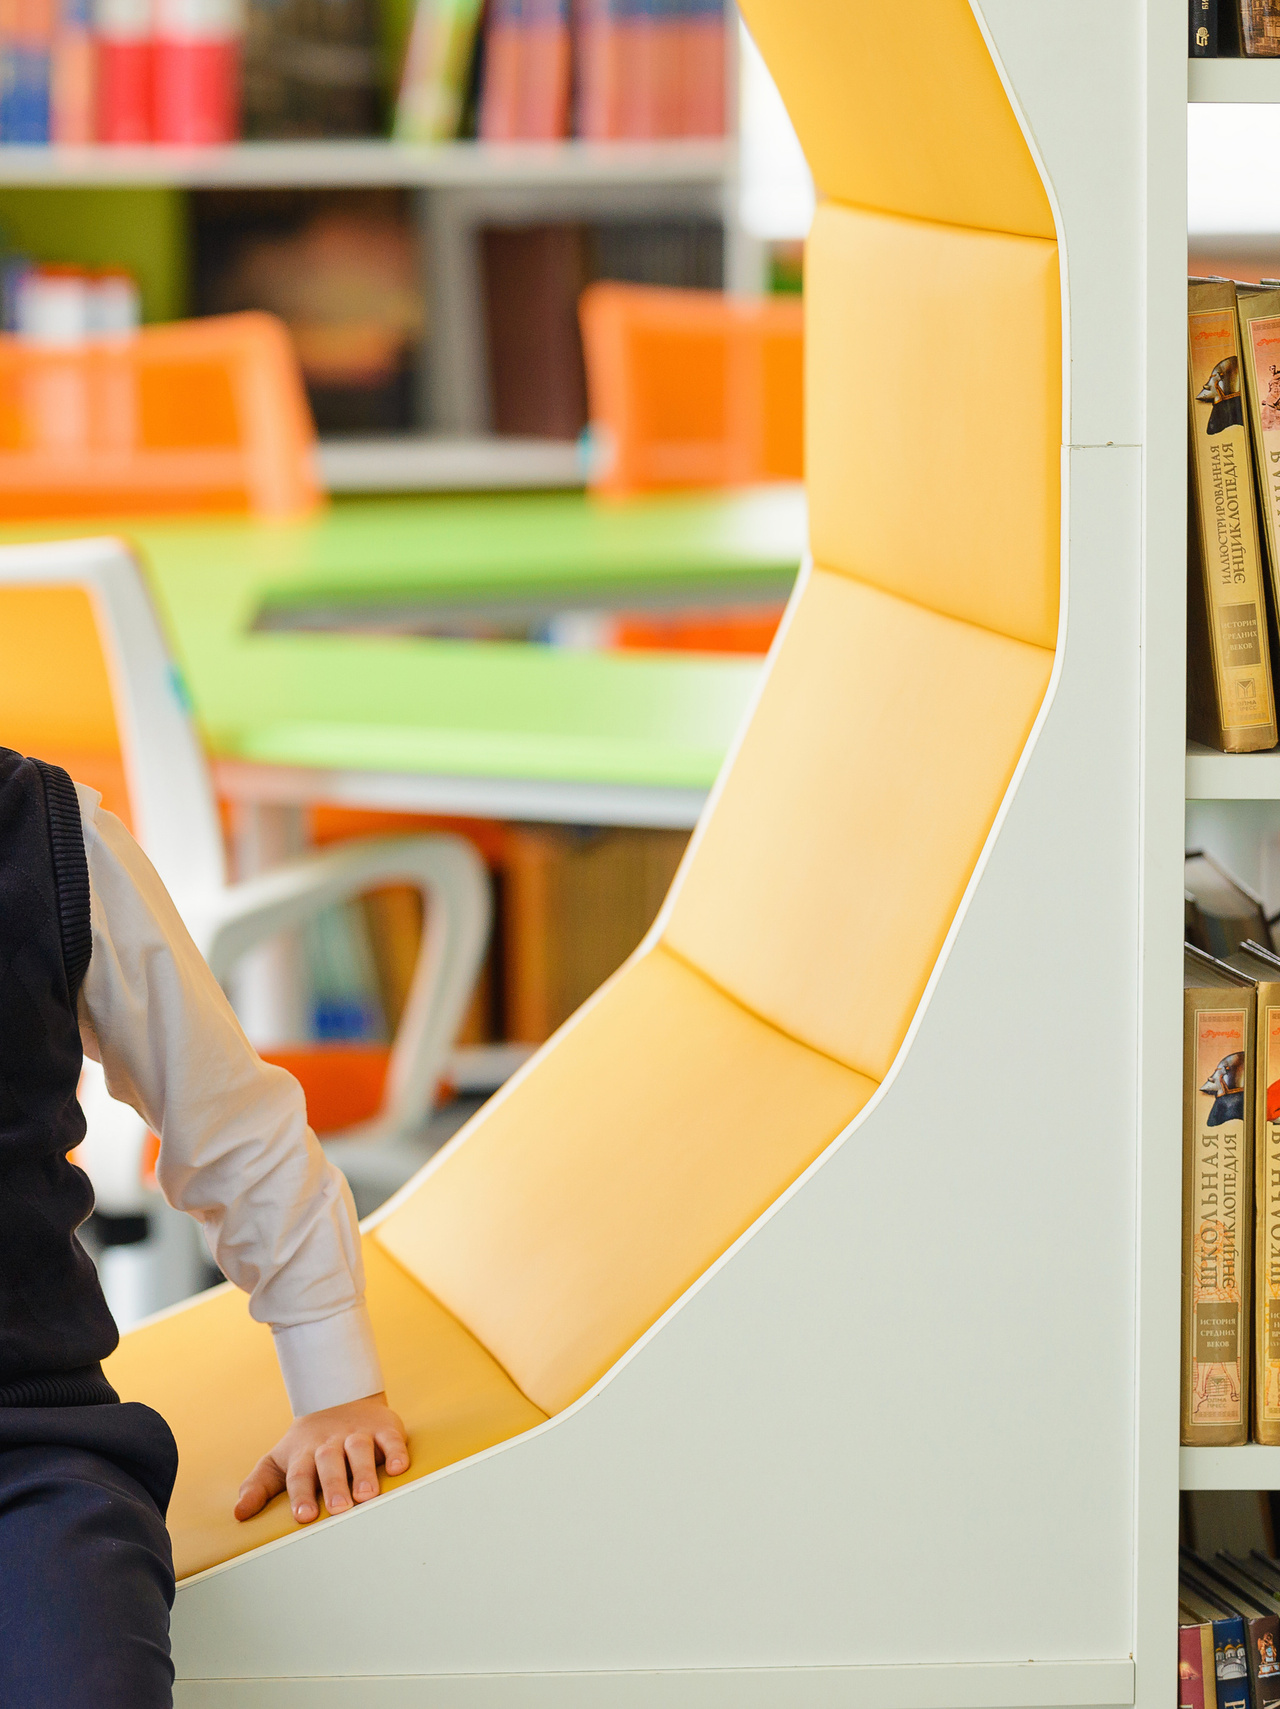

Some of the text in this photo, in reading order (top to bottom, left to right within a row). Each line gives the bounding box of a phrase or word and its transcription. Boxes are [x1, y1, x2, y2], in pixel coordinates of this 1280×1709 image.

[1210, 445, 1232, 585] ИЛЛЮСТРИРОВАННАЯ
[1222, 442, 1247, 584] ЭНЦИКЛОПЕДИЯ
[1221, 619, 1257, 629] ИСТОРИЯ
[1222, 630, 1258, 640] СРЕДНИХ
[1229, 642, 1253, 651] ВЕКОВ
[1200, 1133, 1219, 1289] ШКОЛЬНАЯ
[1222, 1133, 1239, 1289] ЭНЦИКЛОПЕДИЯ
[1200, 1318, 1236, 1326] ИСТОРИЯ
[1200, 1329, 1236, 1337] СРЕДНИХ
[1206, 1340, 1230, 1348] ВЕКОВ
